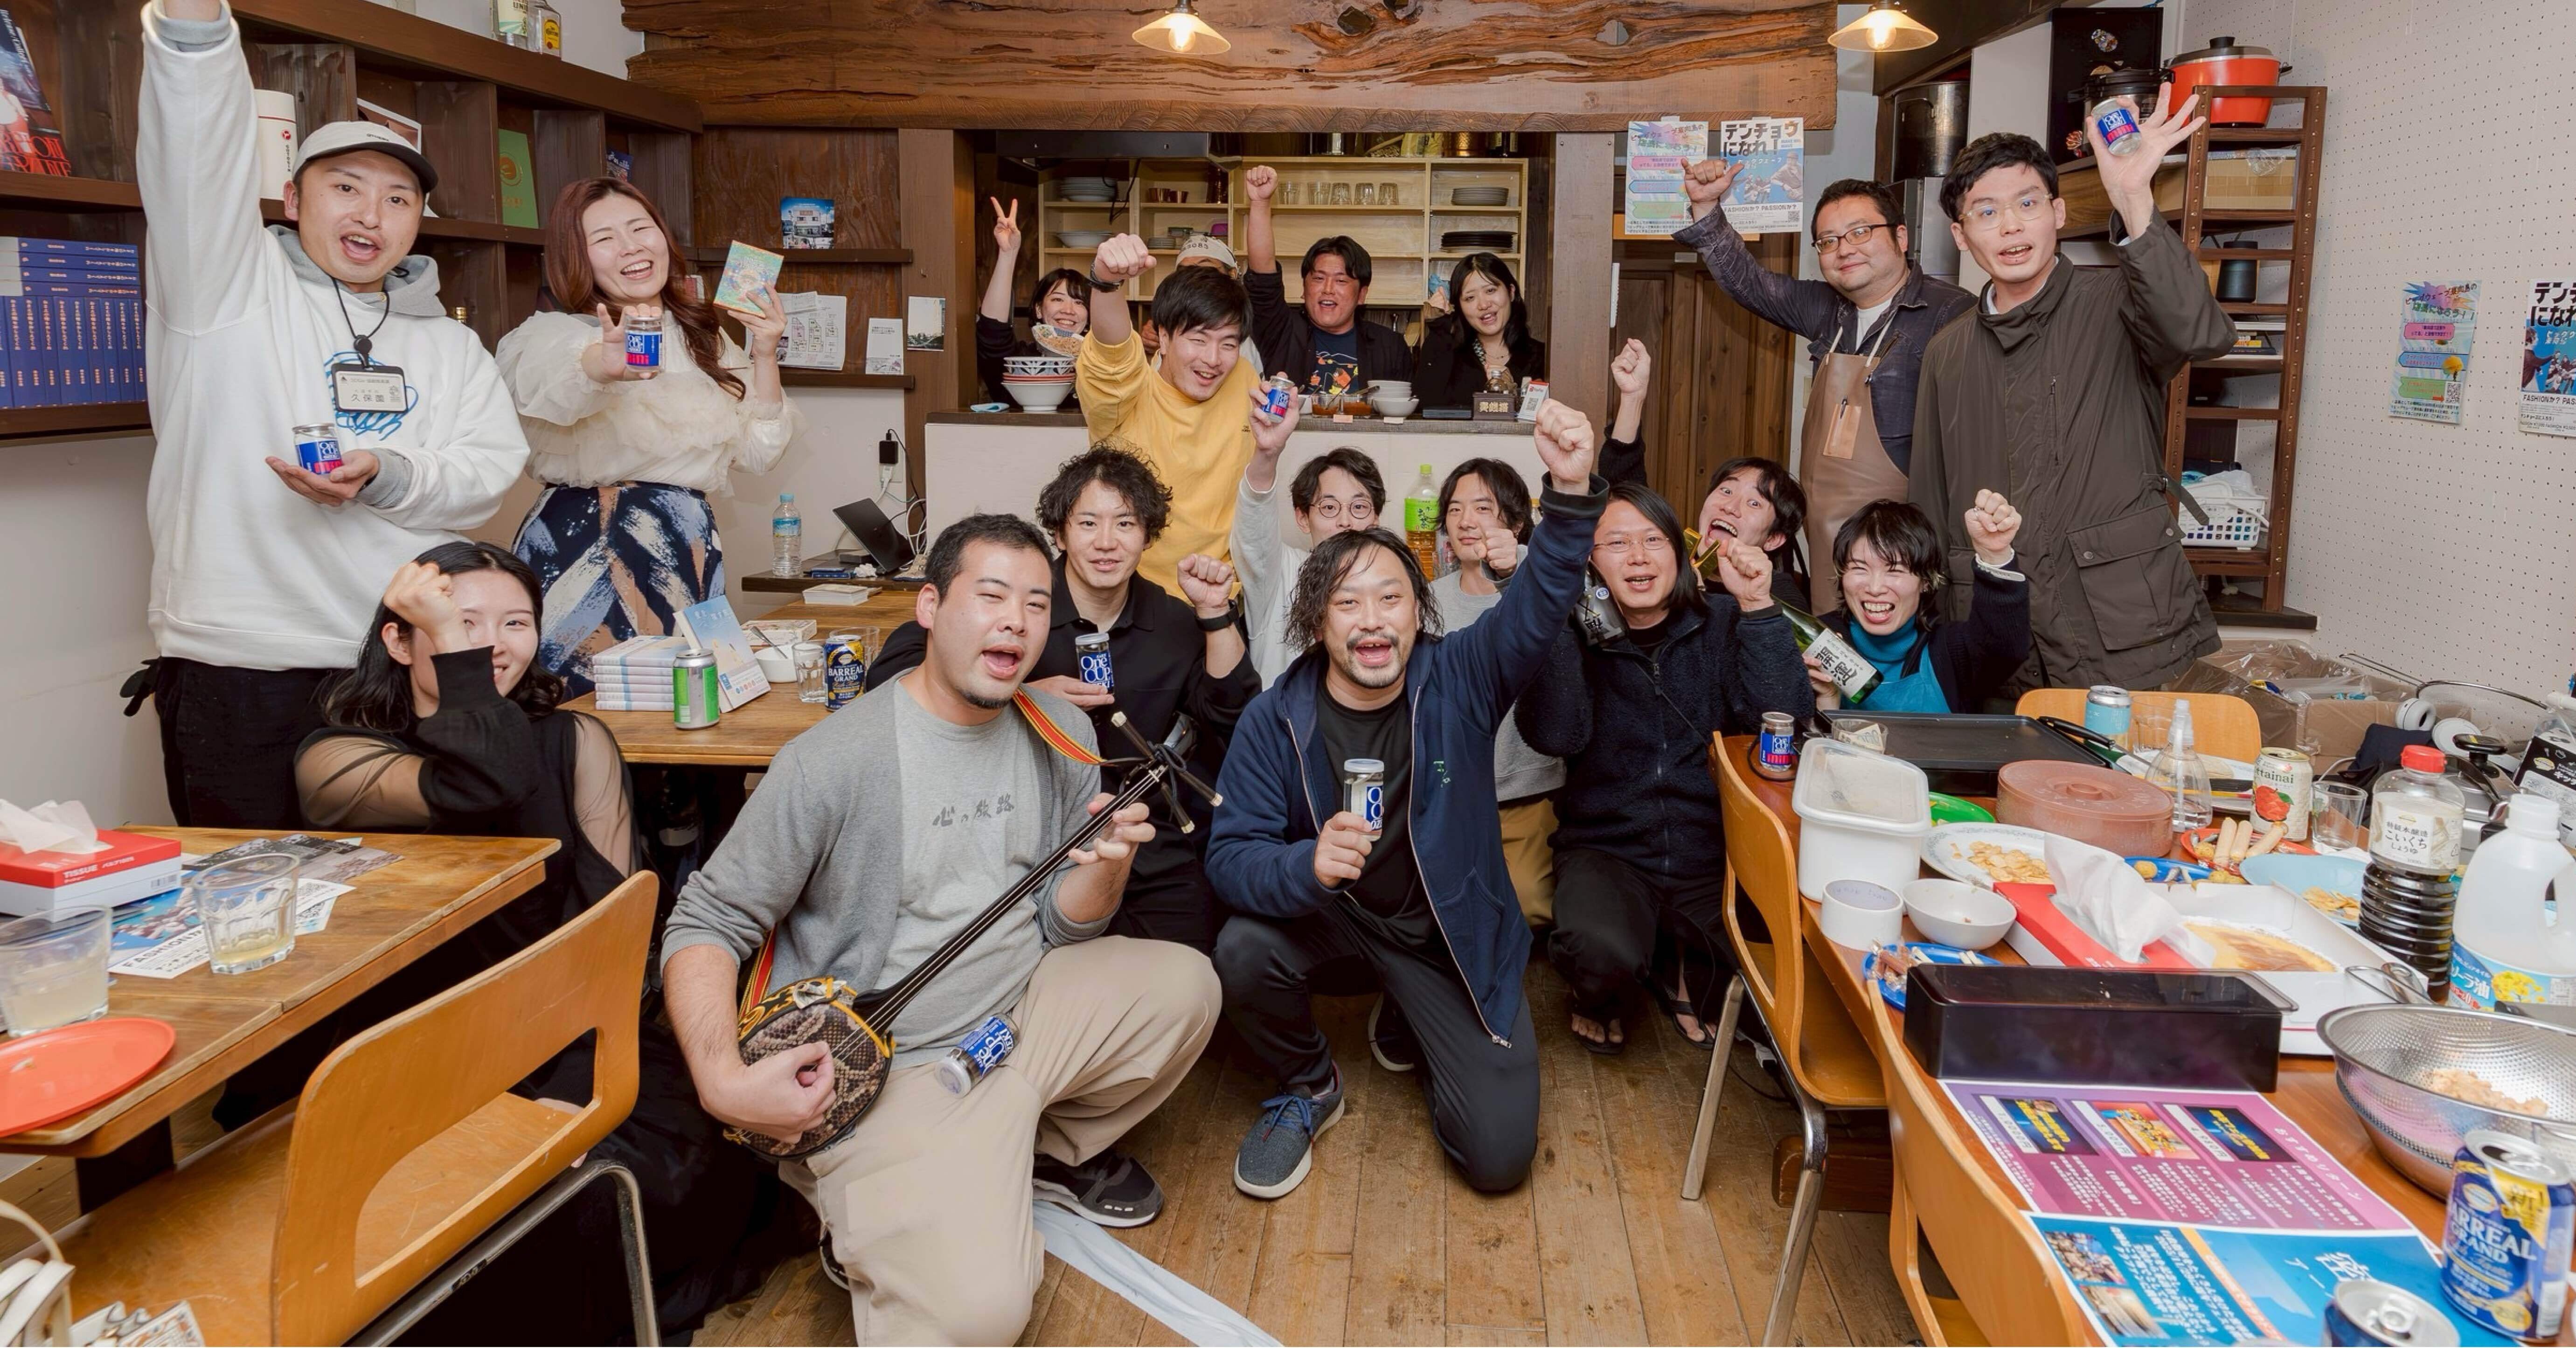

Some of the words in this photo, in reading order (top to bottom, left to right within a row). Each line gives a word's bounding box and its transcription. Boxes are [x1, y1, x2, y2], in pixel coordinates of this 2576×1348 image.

[1725, 121, 1799, 140] テンチョウ
[1723, 140, 1778, 157] になれ！
[828, 664, 864, 676] BARREAL
[1814, 646, 1858, 686] 開運
[2255, 767, 2294, 784] ttainai
[2385, 831, 2427, 849] こいくち
[2391, 842, 2418, 853] しょうゆ
[2270, 1127, 2365, 1200] おすすめリターン
[2452, 1199, 2537, 1261] ARREAL
